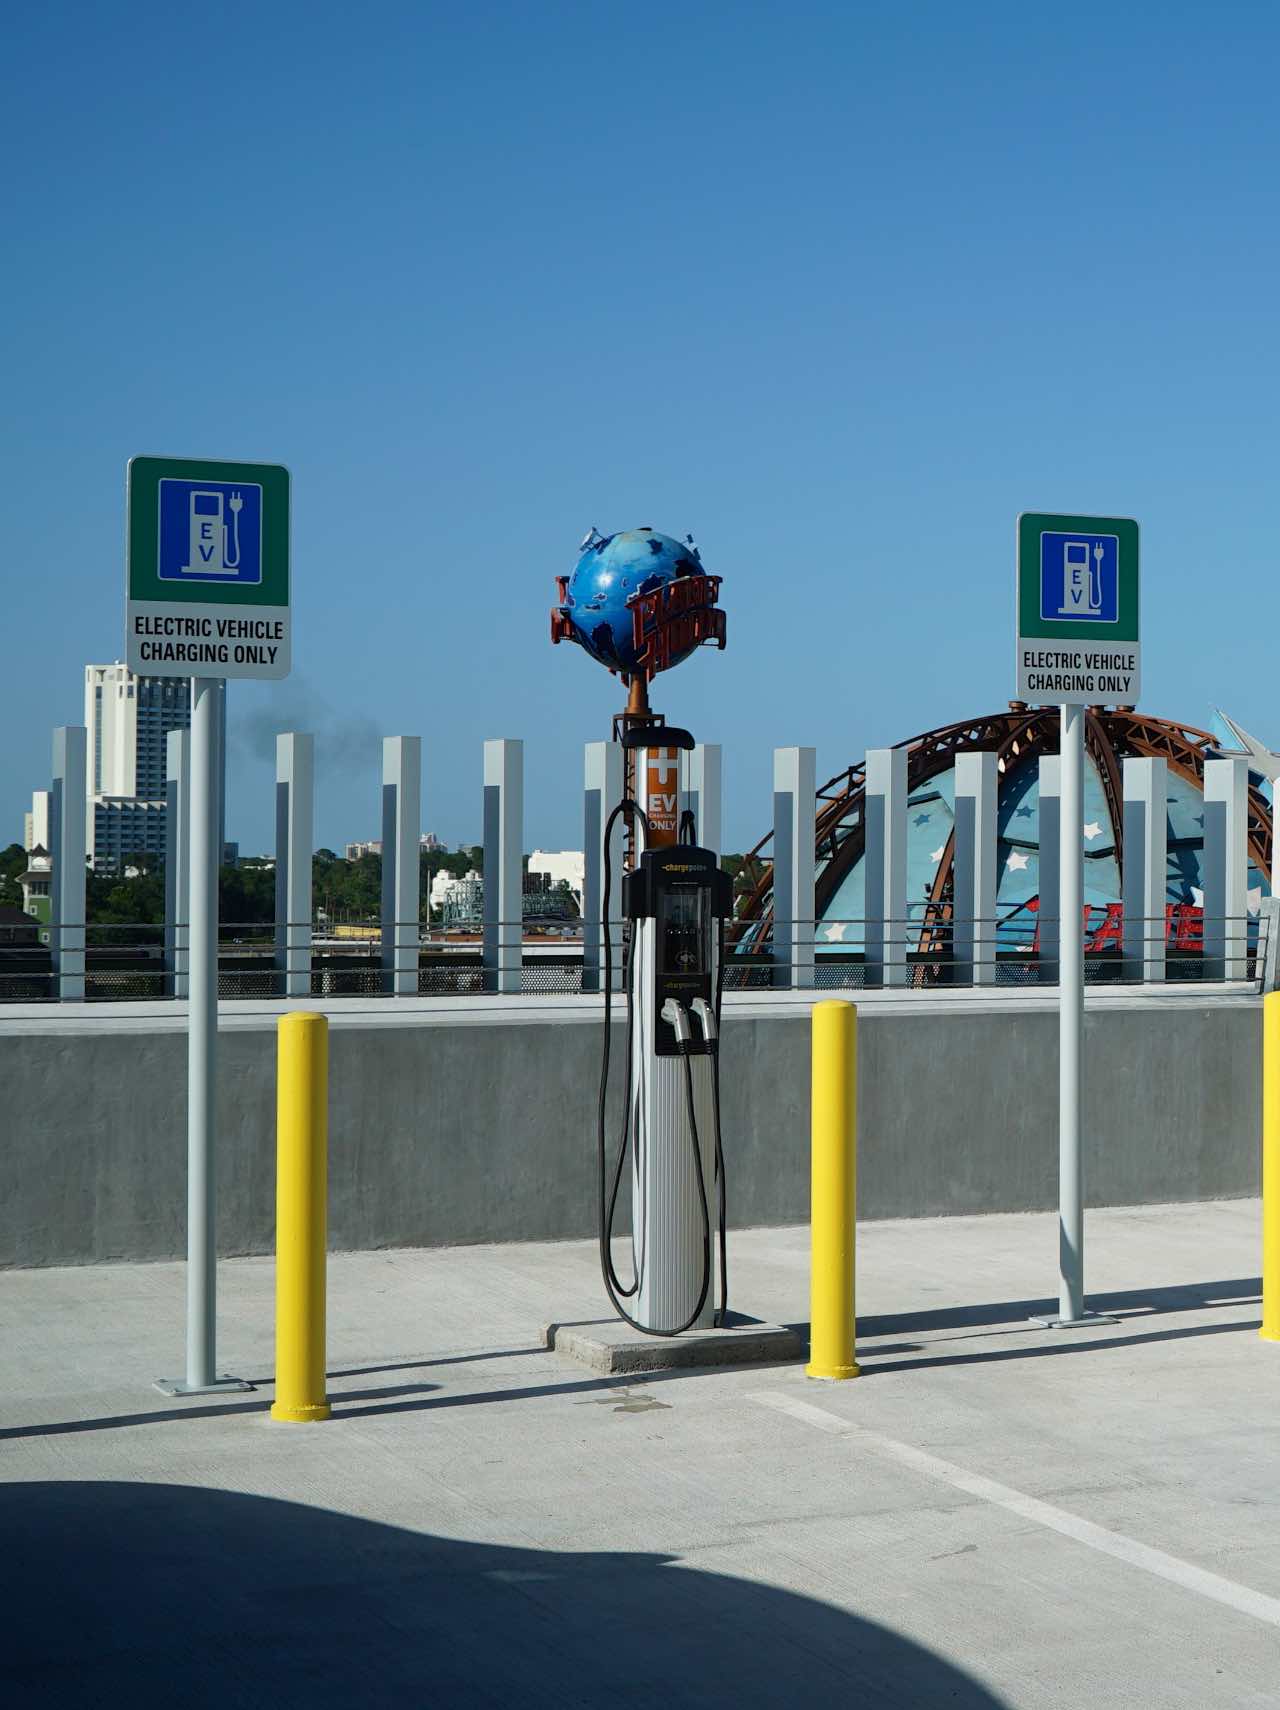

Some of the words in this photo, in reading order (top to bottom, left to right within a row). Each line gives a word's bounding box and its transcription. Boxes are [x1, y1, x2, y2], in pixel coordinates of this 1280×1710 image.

[135, 616, 212, 637] ELECTRIC
[217, 619, 283, 640] VEHICLE
[140, 641, 229, 663] CHARGING
[234, 645, 278, 665] ONLY
[1023, 651, 1081, 669] ELECTRIC
[1085, 653, 1135, 671] VEHICLE
[1028, 674, 1094, 692] CHARGING
[1099, 676, 1132, 692] ONLY
[649, 793, 676, 812] EV
[649, 820, 676, 831] ONLY
